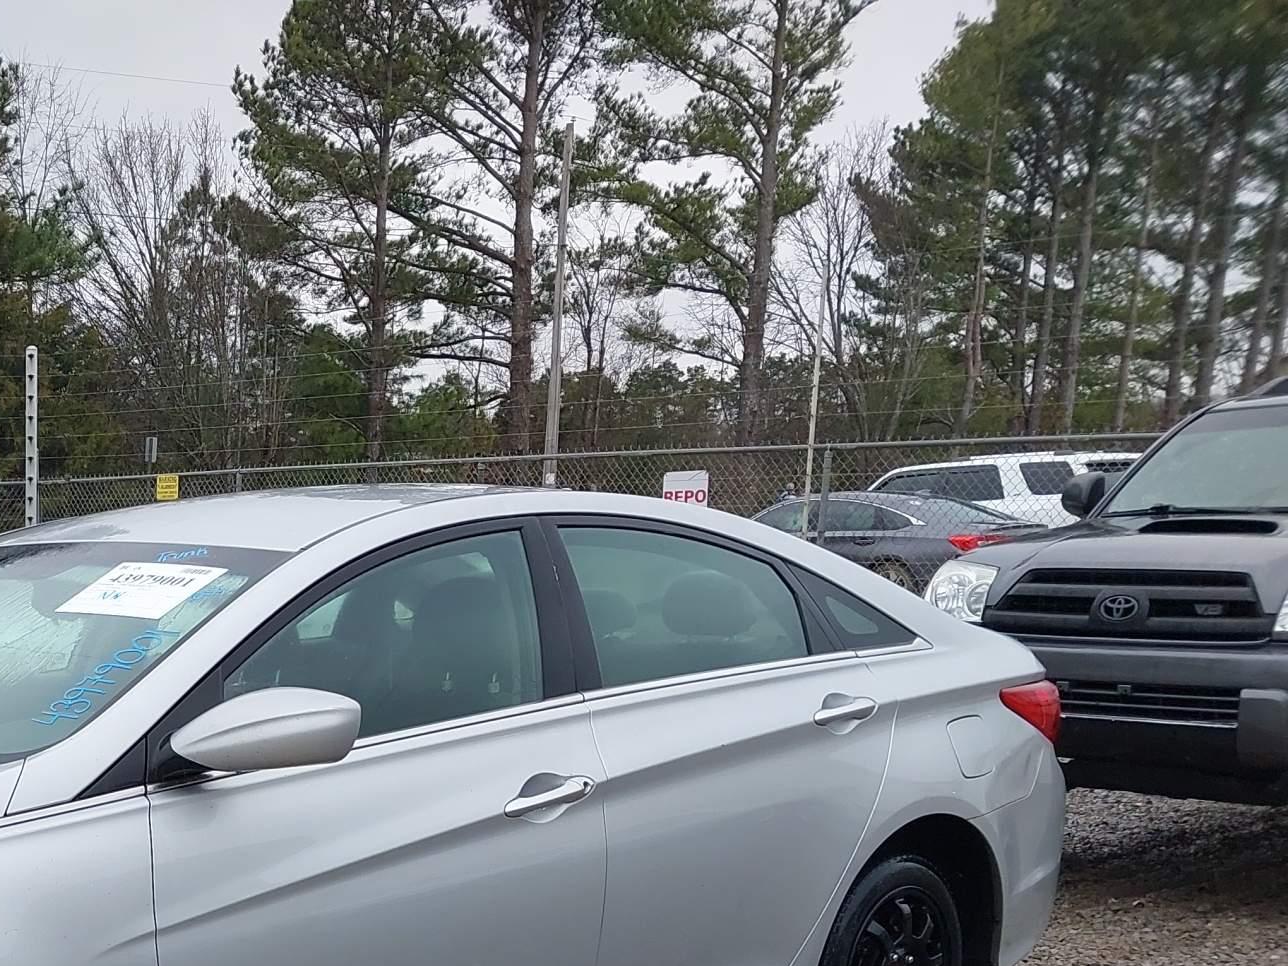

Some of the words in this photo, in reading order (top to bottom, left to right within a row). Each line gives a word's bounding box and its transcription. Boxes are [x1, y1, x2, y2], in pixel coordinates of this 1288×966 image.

[664, 490, 706, 503] REPO
[110, 574, 195, 588] 43979001
[32, 628, 181, 725] 43979001
